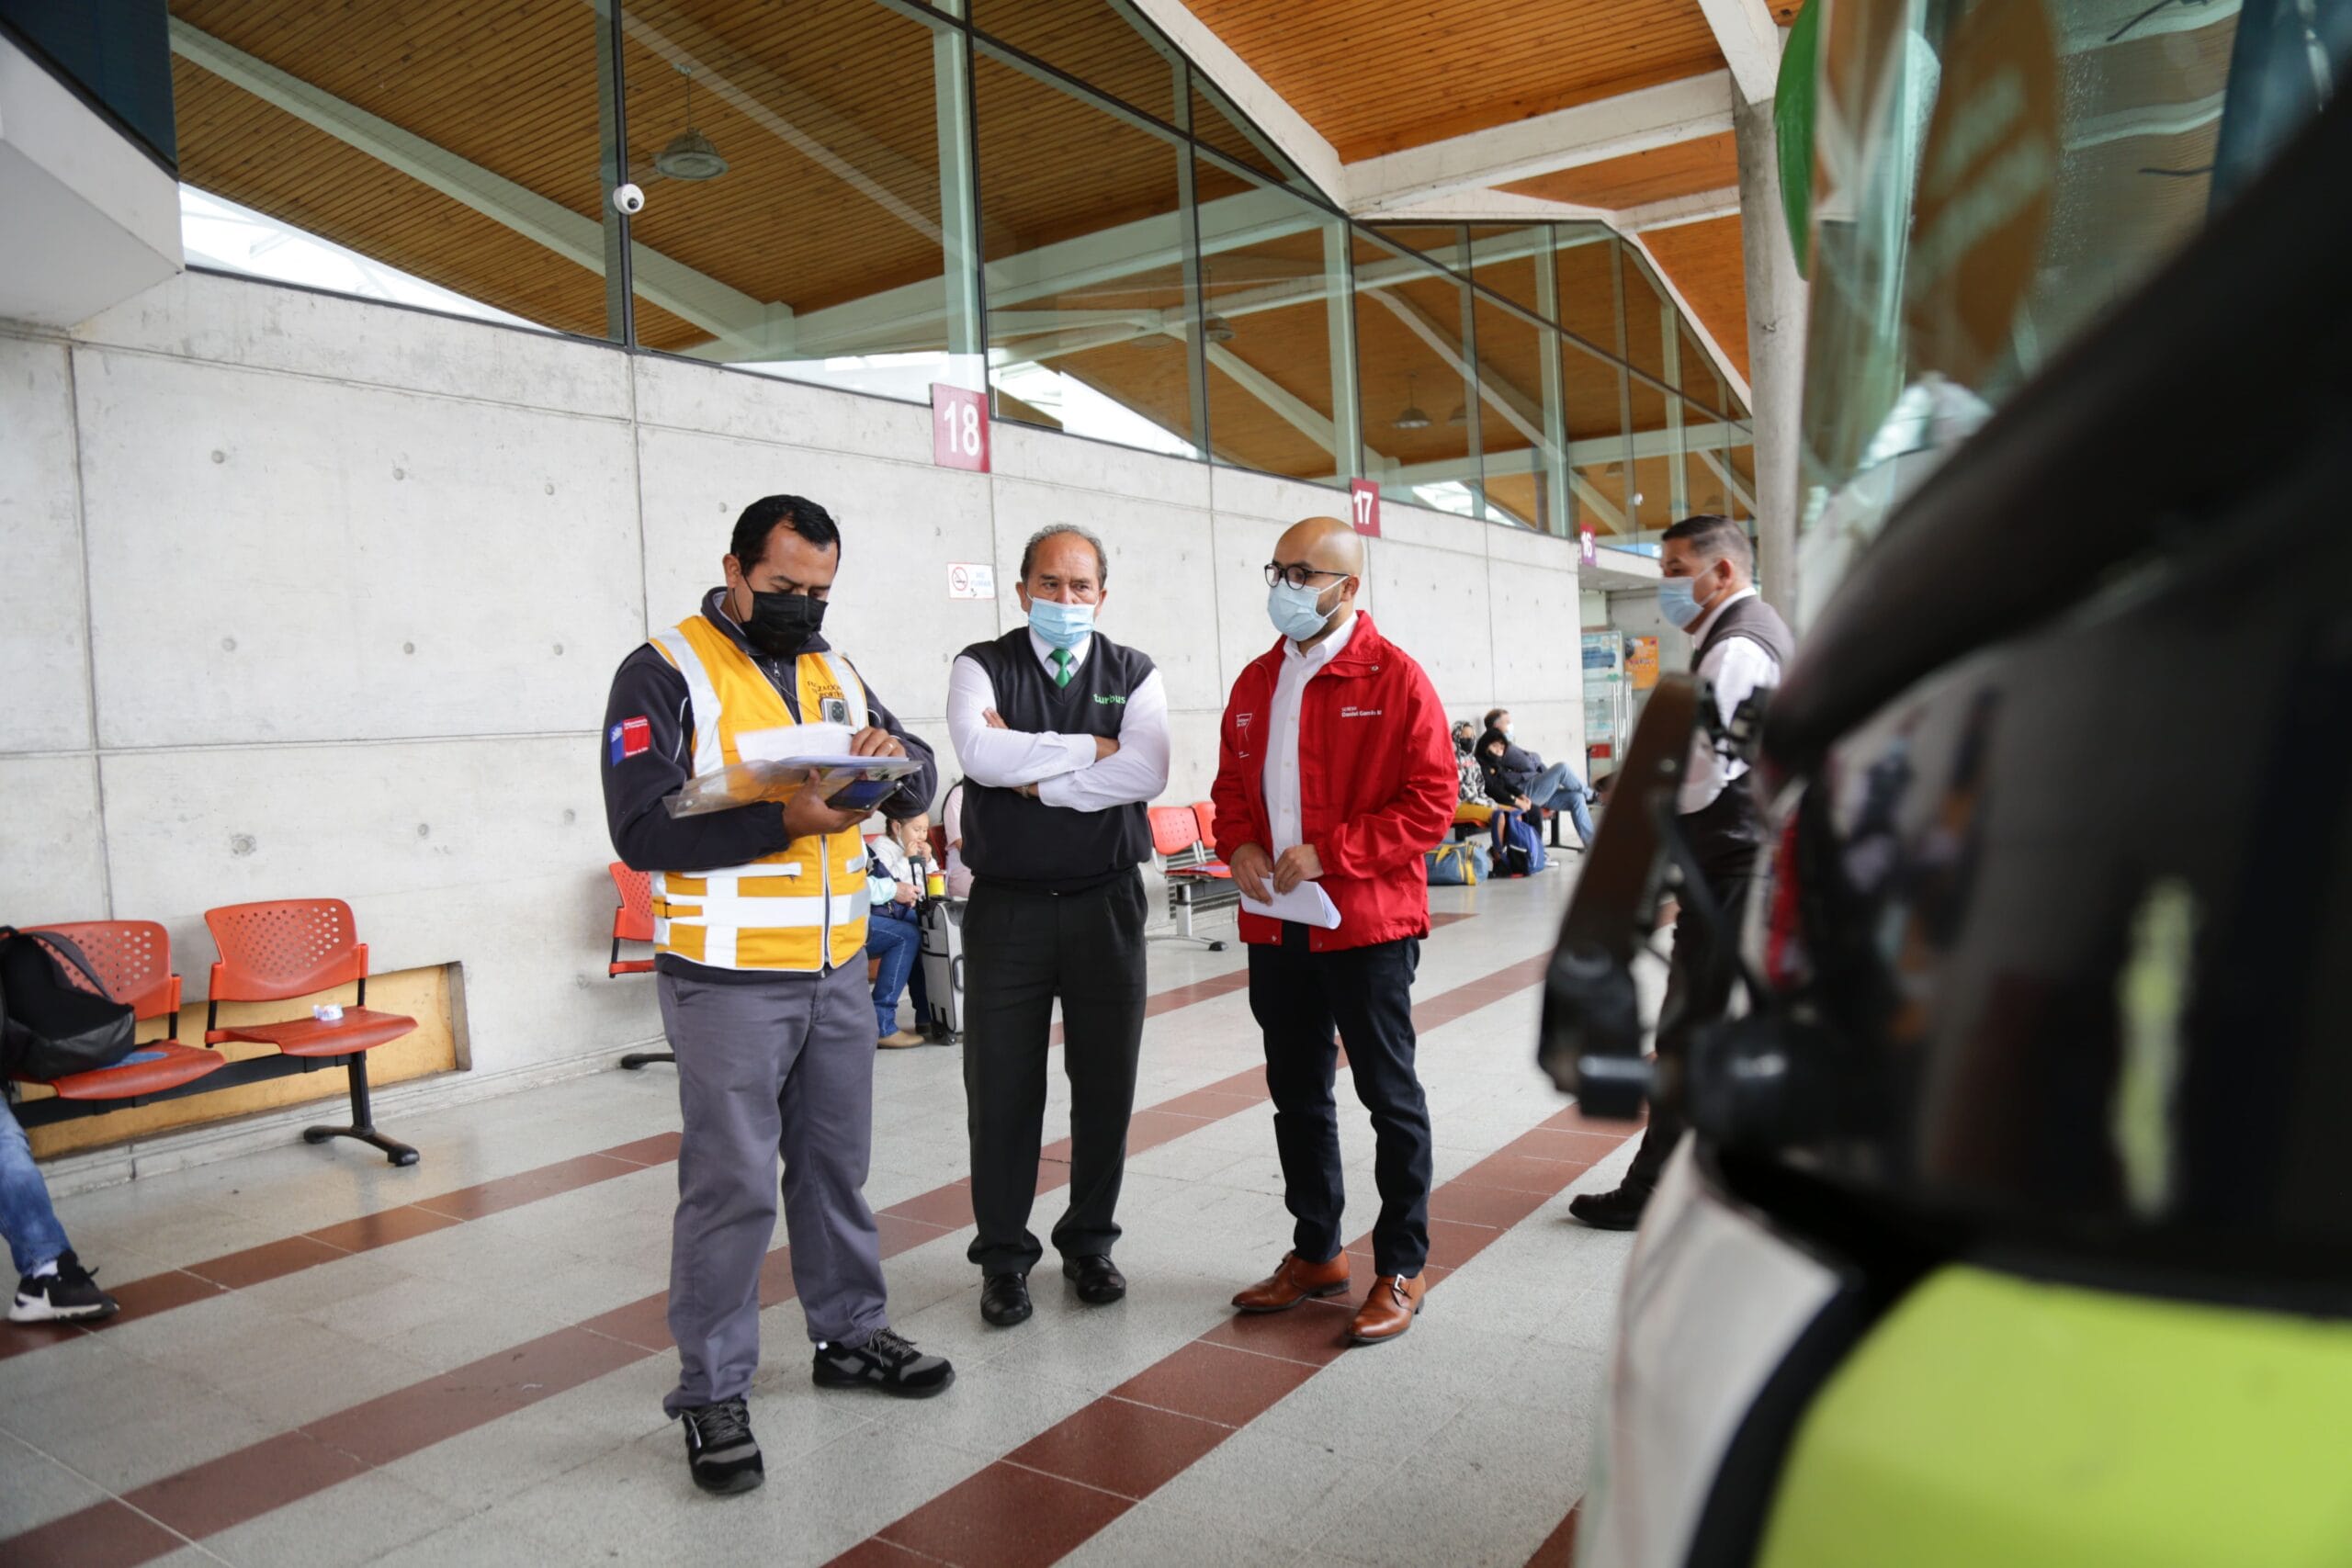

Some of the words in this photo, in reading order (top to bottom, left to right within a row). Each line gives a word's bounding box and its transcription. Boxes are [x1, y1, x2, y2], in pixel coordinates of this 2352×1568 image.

[944, 400, 980, 457] 18
[1353, 490, 1374, 525] 17
[1581, 531, 1592, 558] 16
